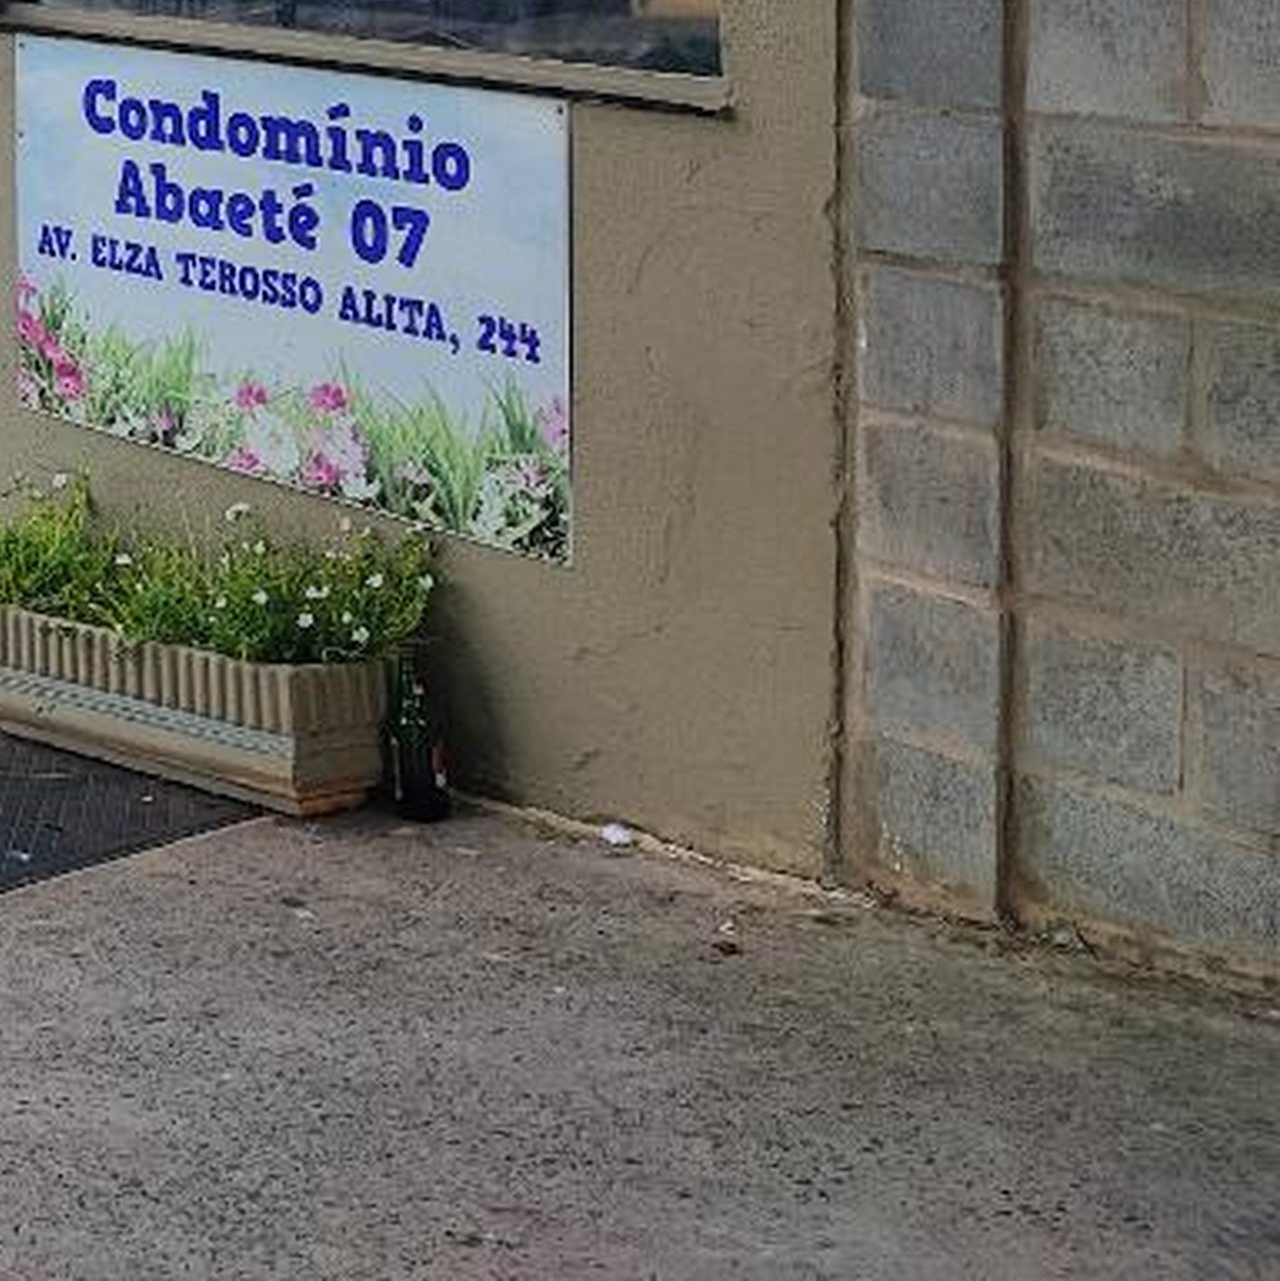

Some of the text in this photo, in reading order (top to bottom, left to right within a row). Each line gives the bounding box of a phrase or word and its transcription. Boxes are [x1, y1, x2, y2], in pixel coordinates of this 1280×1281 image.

[83, 79, 471, 192] Condomínio
[115, 159, 431, 268] Abaeté 07
[38, 224, 541, 364] AV. ELZA TEROSSO ALITA, 244
